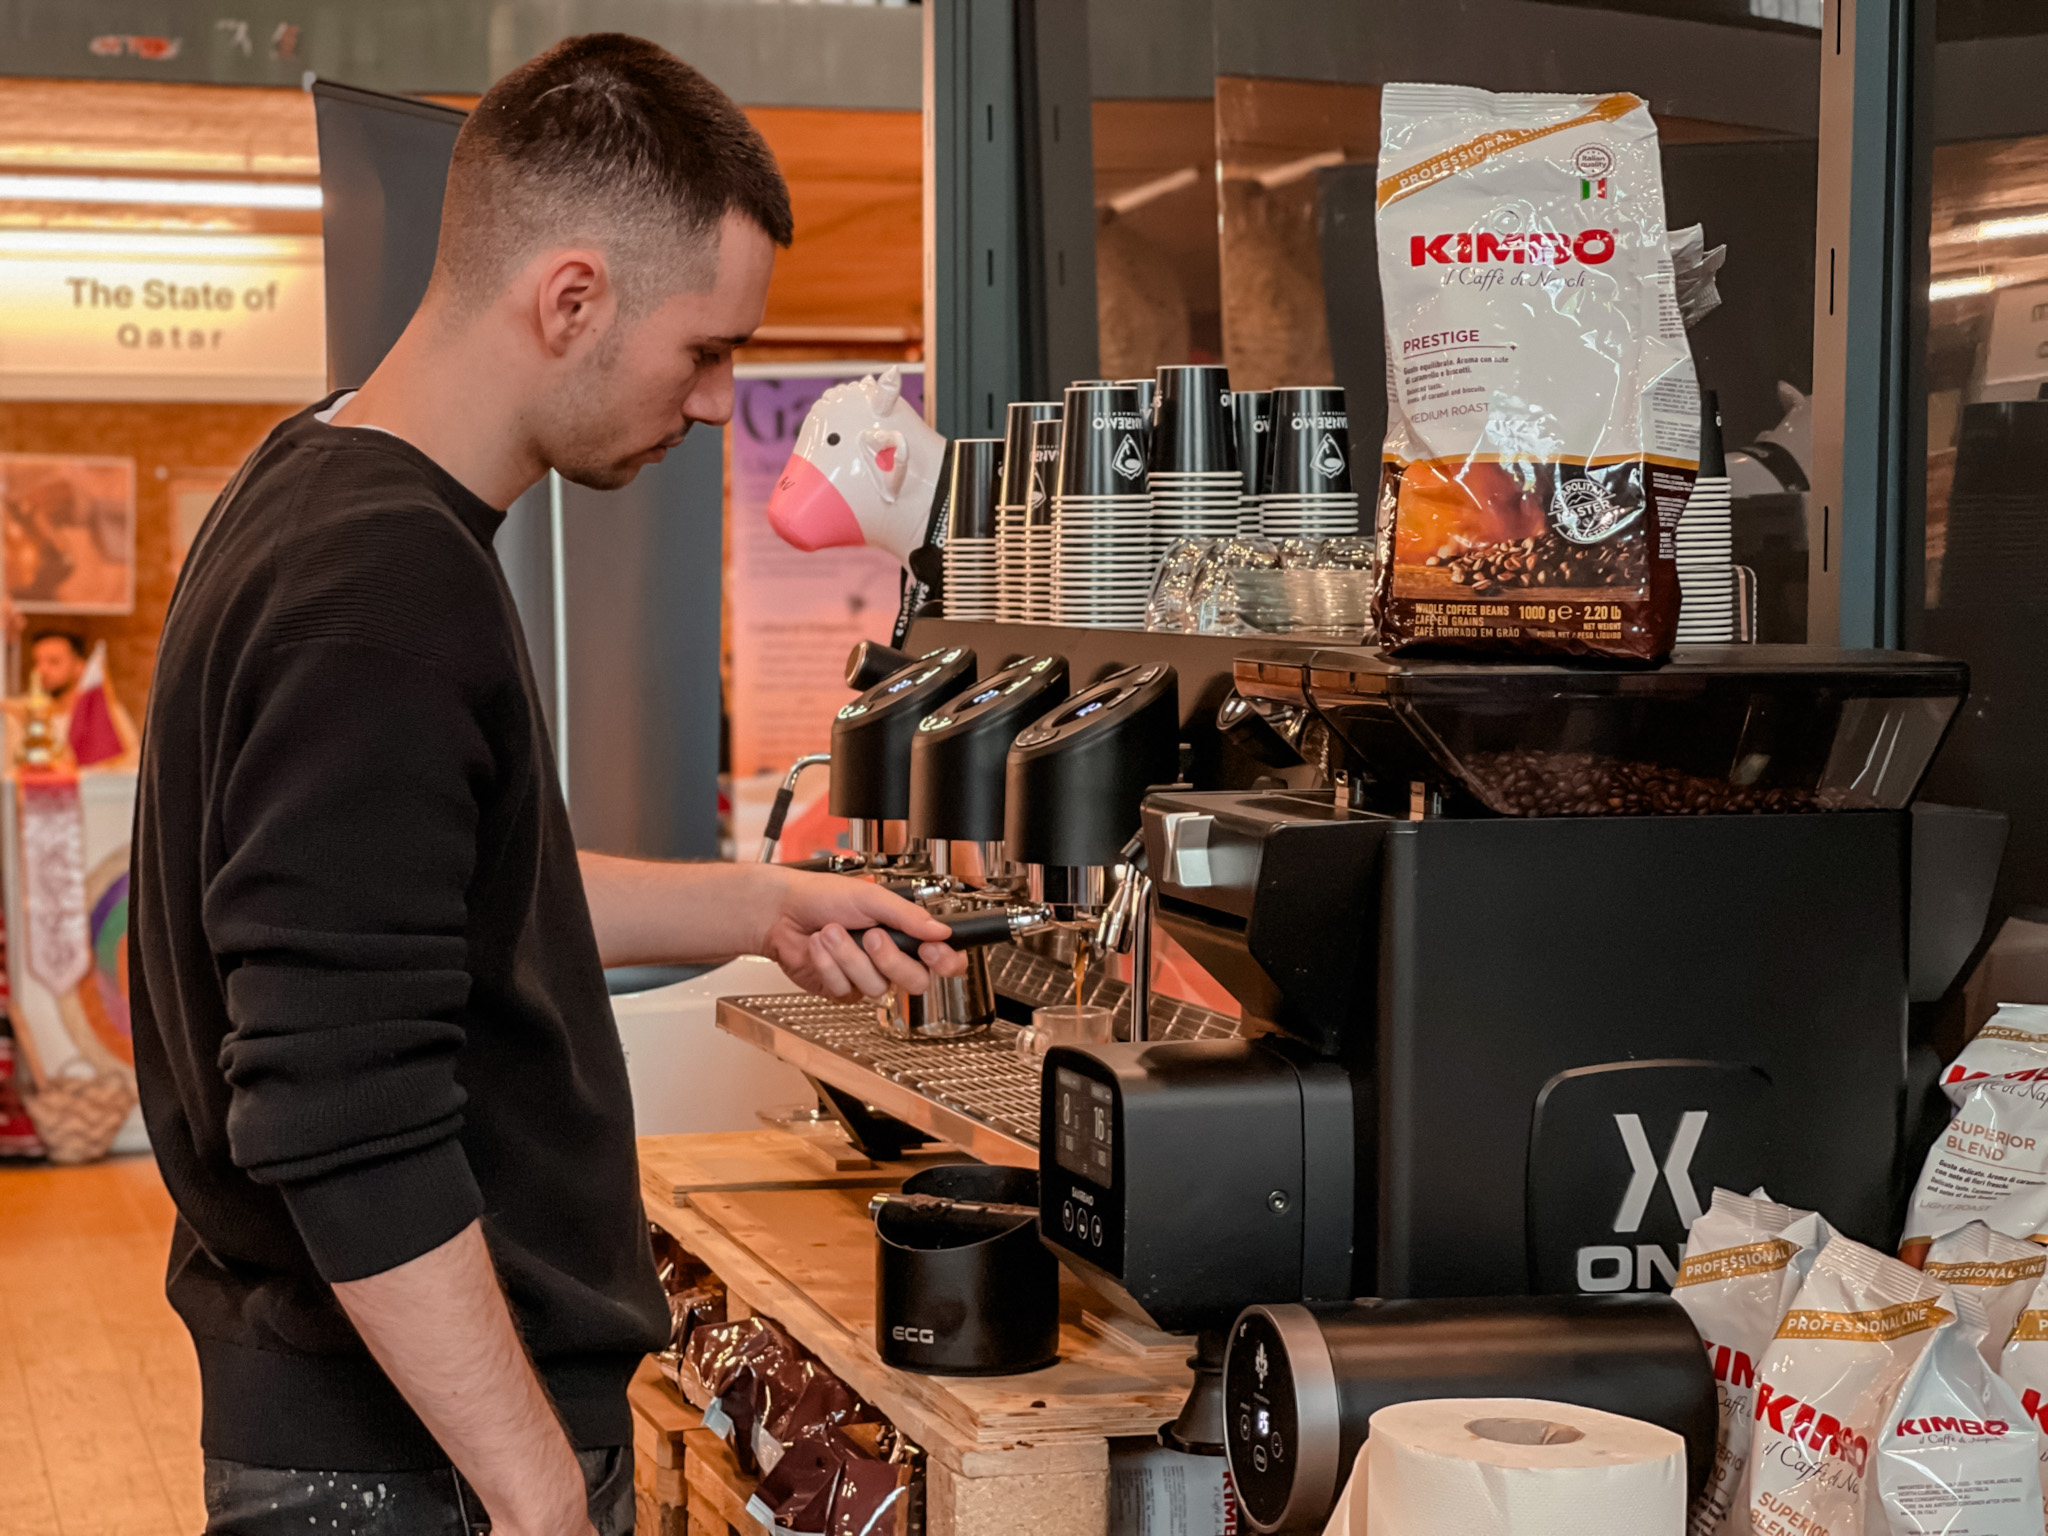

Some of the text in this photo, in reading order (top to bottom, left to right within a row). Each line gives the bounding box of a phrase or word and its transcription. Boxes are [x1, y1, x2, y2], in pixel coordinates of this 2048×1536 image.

[1399, 131, 1517, 188] PROFESSIONAL
[1410, 229, 1615, 267] KIMBO
[1459, 267, 1505, 291] Caffè
[1510, 270, 1524, 286] di
[64, 276, 278, 311] The State of
[117, 321, 223, 350] Qatar
[1403, 329, 1480, 354] PRESTIGE
[1451, 402, 1490, 416] ROAST
[1415, 602, 1445, 616] WHOLE
[1446, 603, 1477, 616] COFFEE
[1480, 604, 1509, 616] BEANS
[1519, 605, 1546, 620] 1000
[1584, 605, 1608, 620] 2.20
[1610, 605, 1622, 620] lb
[1437, 615, 1448, 626] EN
[1451, 616, 1484, 627] GRAINS
[1437, 627, 1477, 637] TORRADO
[1480, 628, 1493, 637] EM
[1583, 622, 1622, 630] NET WEIGHT
[1950, 1118, 2037, 1151] SUPERIOR
[1946, 1134, 2006, 1161] BLEND
[1613, 1110, 1709, 1233] X
[1934, 1167, 1947, 1176] con
[1948, 1171, 1963, 1181] note
[1971, 1176, 1986, 1186] fiori
[1938, 1159, 1958, 1171] Gusto
[1986, 1172, 2008, 1182] Aroma
[1919, 1199, 1992, 1212] LIGHT ROAST
[1577, 1243, 1688, 1292] ON
[1686, 1246, 1788, 1278] PROFESSIONAL
[1922, 1261, 2046, 1279] OFESSIONAL LINE
[1786, 1308, 1929, 1334] PROFESSIONAL LINE
[892, 1325, 935, 1344] ECG
[1895, 1415, 2009, 1437] KIMBO
[1762, 1441, 1782, 1456] il
